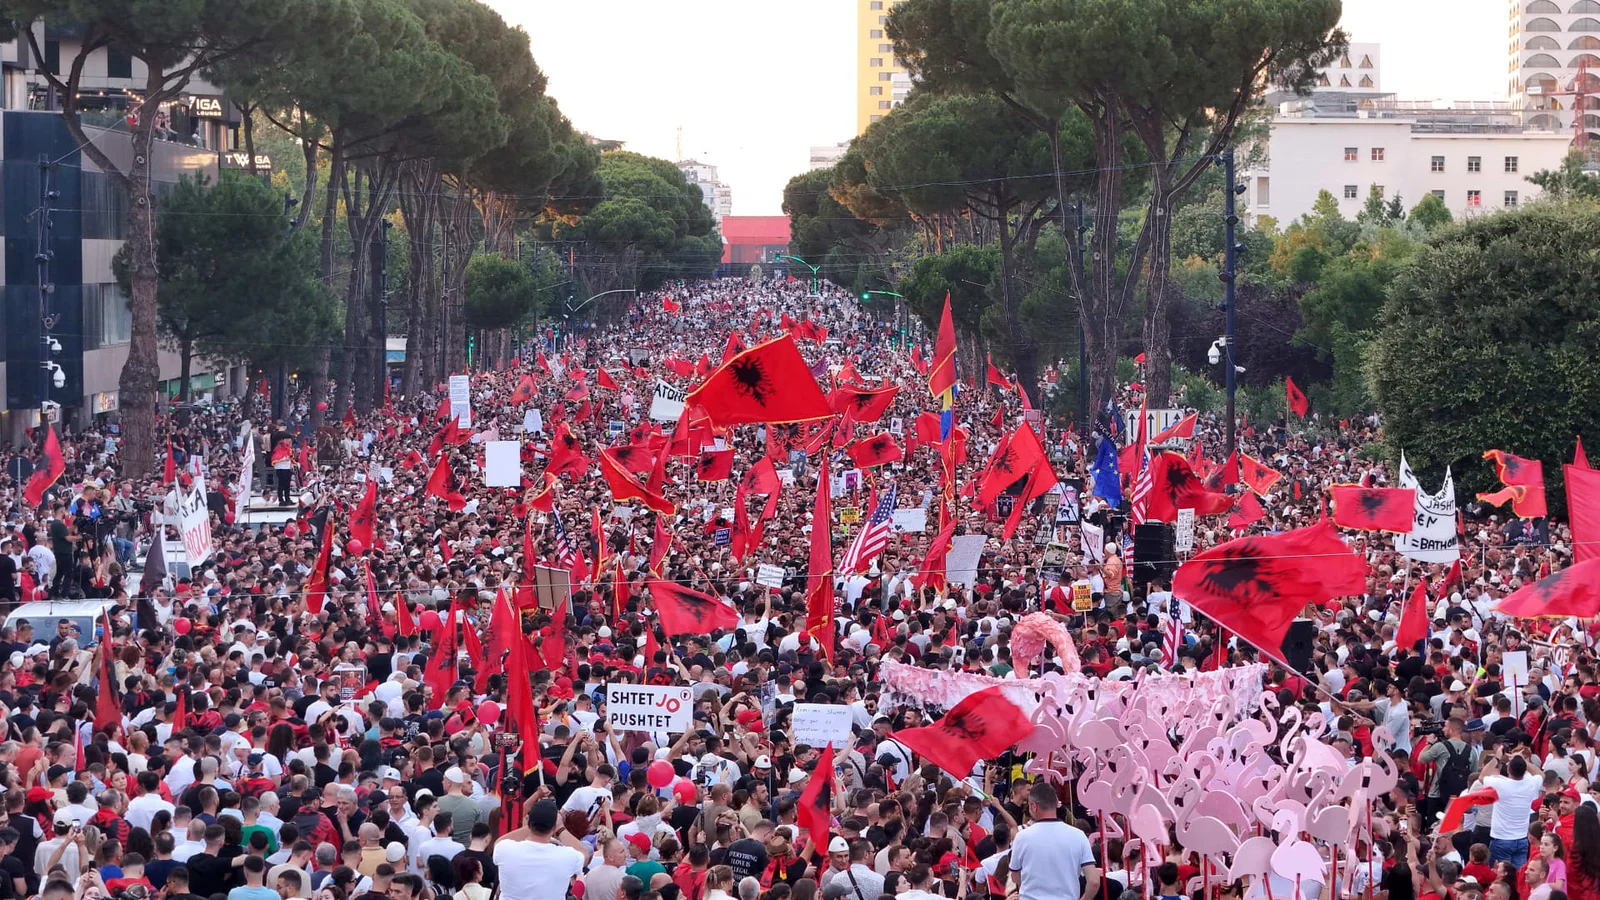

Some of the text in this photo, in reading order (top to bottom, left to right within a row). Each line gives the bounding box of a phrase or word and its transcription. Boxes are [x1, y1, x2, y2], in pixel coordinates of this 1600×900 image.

[225, 153, 271, 167] TWGA
[611, 691, 680, 713] SHTET JO
[611, 713, 671, 727] PUSHTET
